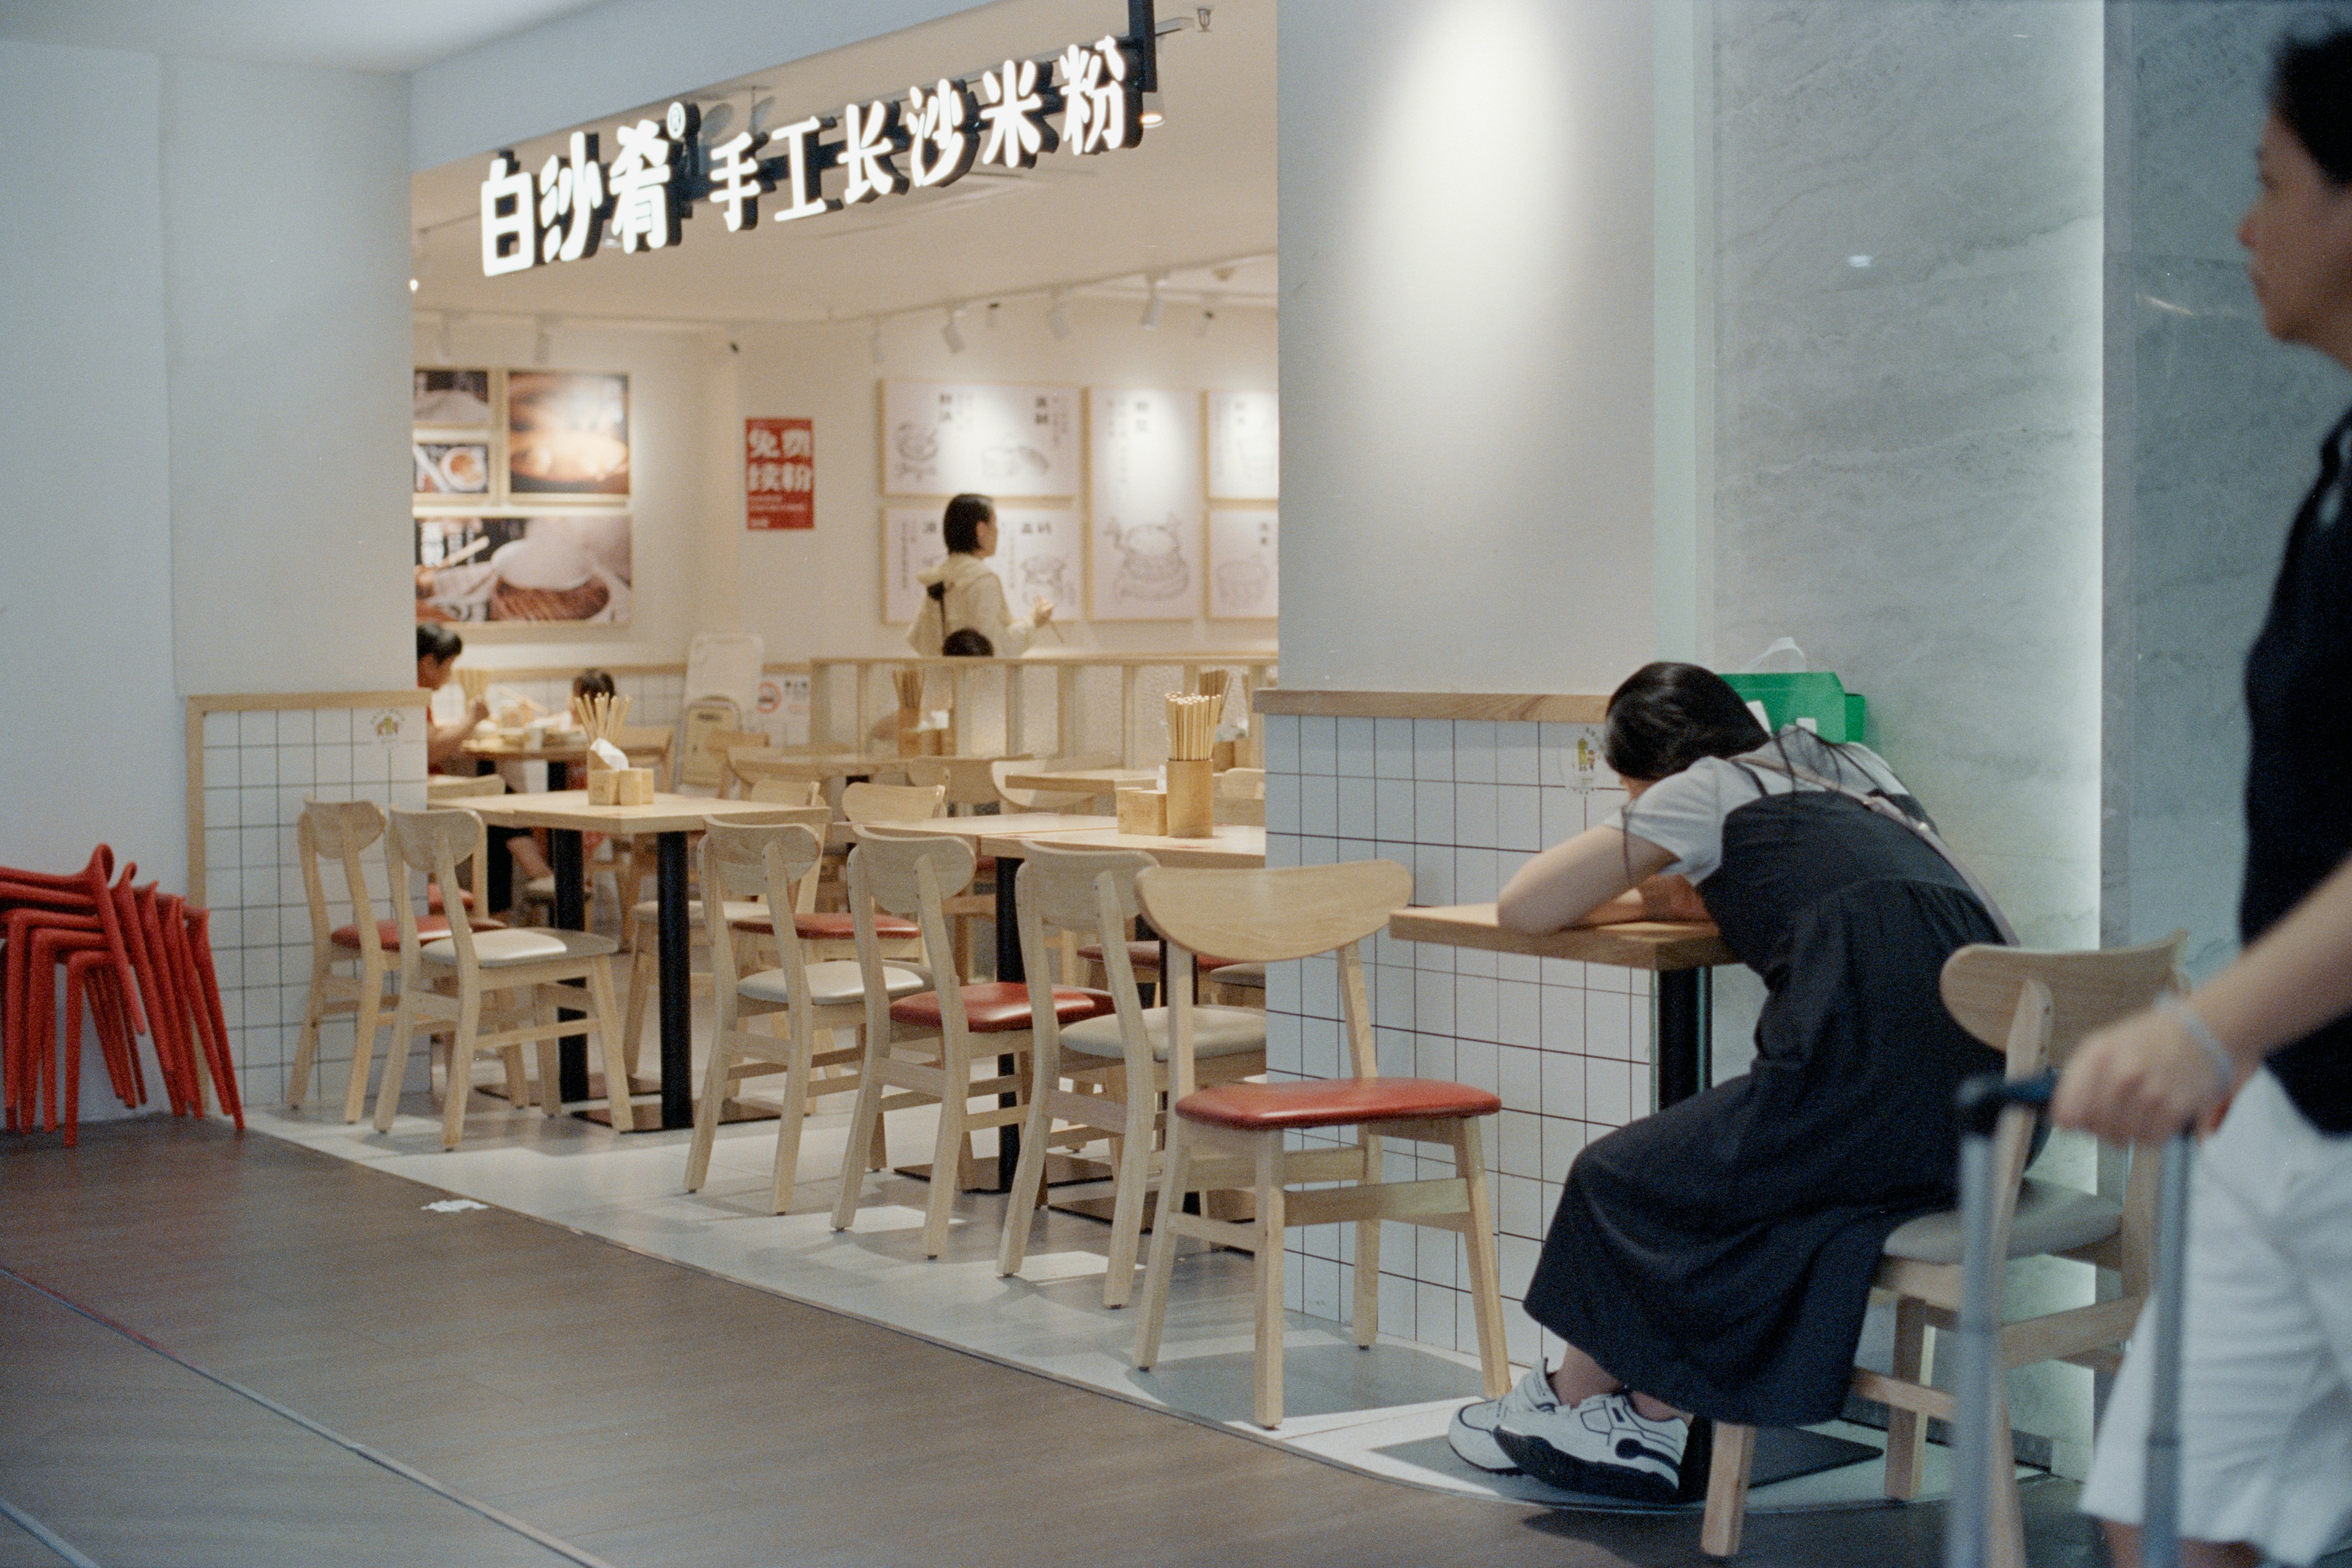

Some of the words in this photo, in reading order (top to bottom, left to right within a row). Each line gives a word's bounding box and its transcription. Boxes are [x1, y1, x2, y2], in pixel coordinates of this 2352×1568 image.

[710, 35, 1124, 233] 手工长沙米粉
[749, 428, 811, 459] 免费
